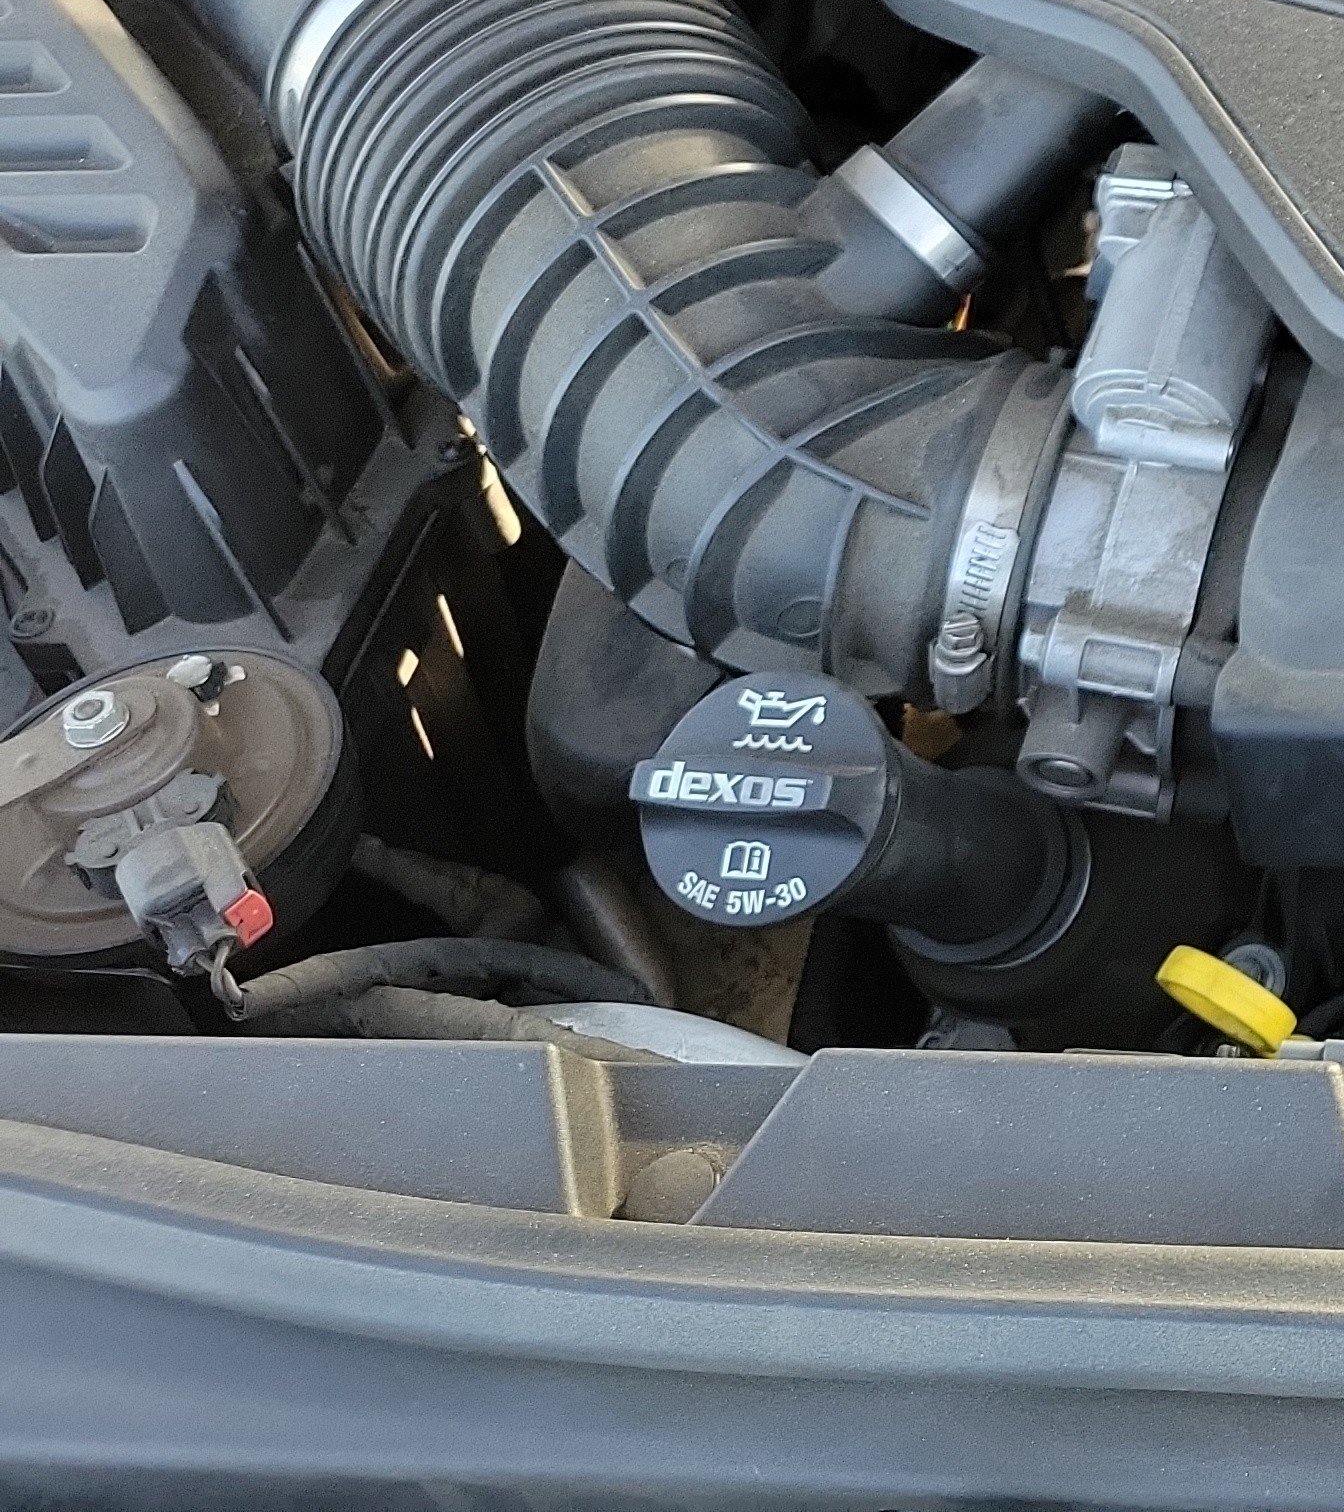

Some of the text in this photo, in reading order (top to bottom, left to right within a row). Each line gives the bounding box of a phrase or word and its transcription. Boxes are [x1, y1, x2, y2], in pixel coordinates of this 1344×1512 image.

[648, 760, 808, 808] dexos
[677, 870, 808, 915] SAE 5W-30
